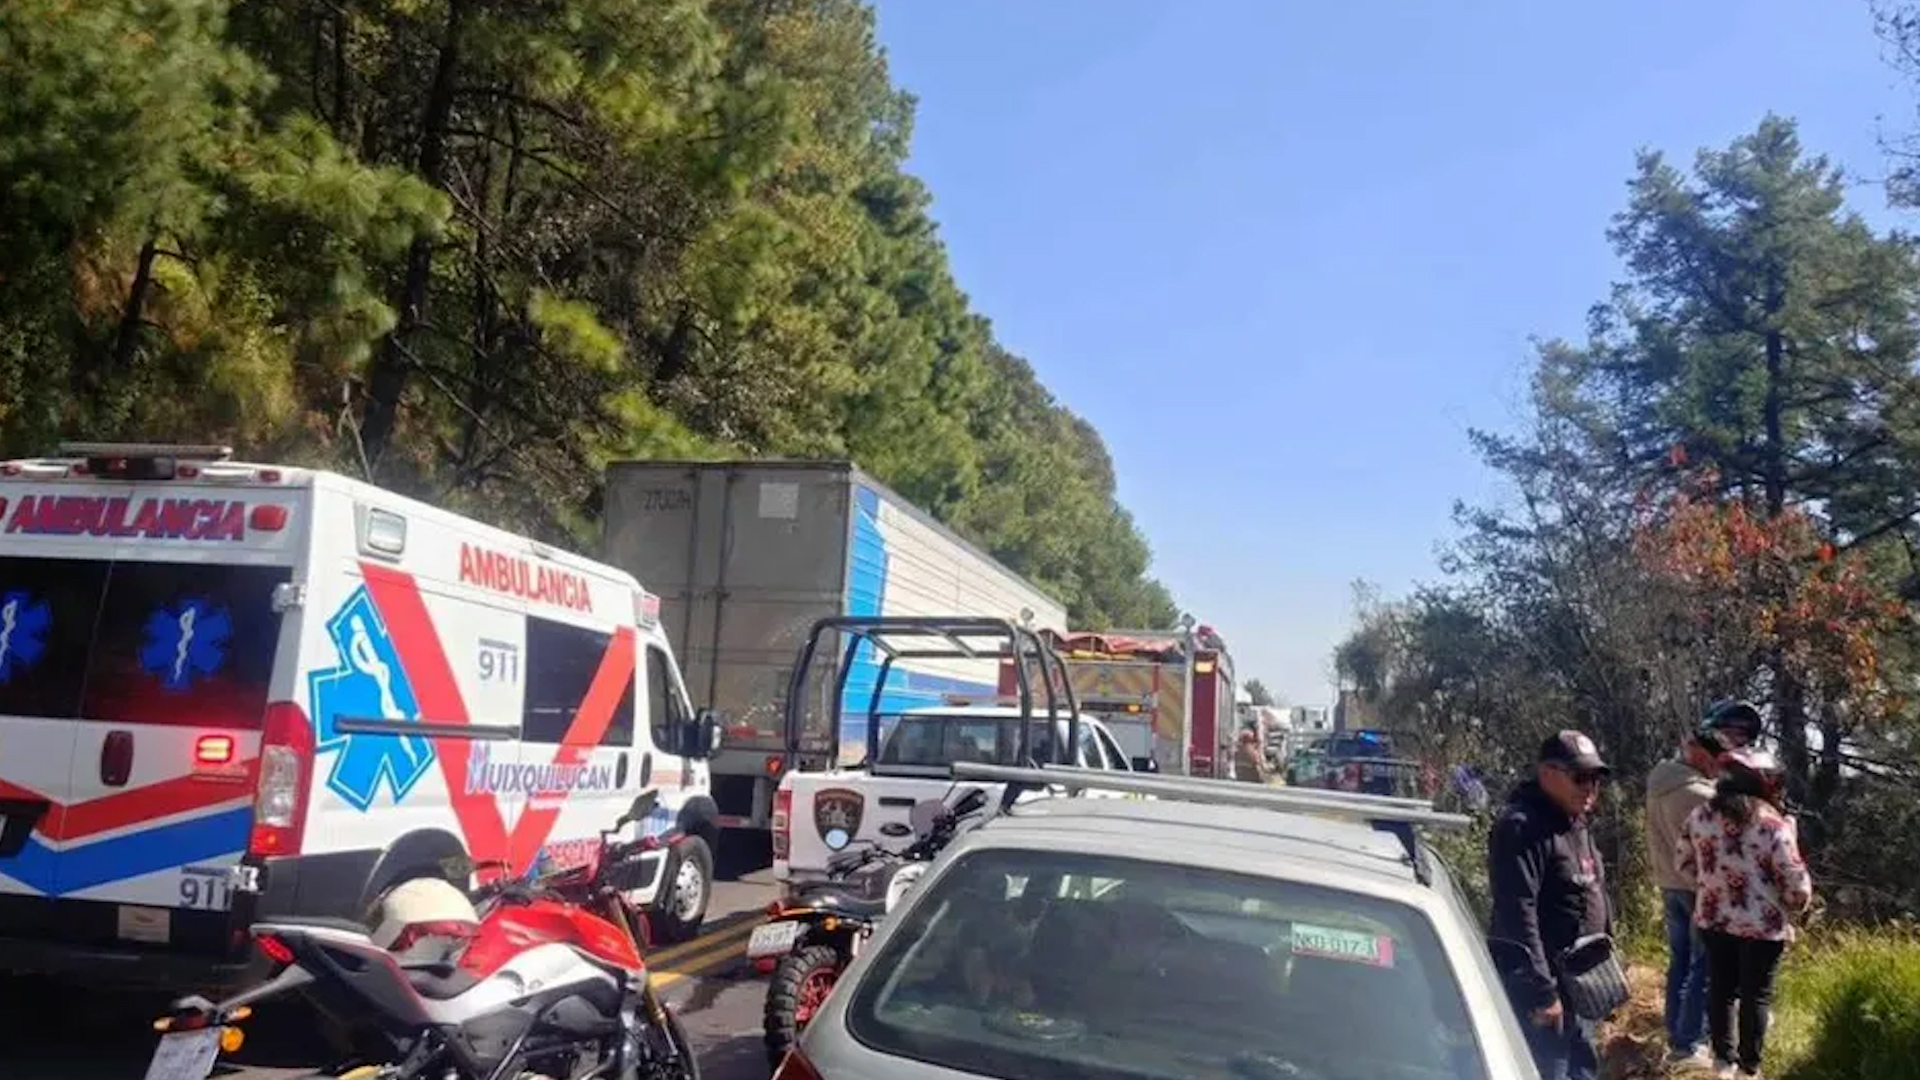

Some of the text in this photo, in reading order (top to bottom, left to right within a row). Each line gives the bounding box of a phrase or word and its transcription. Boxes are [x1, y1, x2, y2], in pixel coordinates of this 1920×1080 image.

[4, 495, 245, 541] AMBULANCIA
[459, 542, 592, 613] AMBULANCIA
[478, 650, 518, 683] 911
[179, 877, 232, 911] 911
